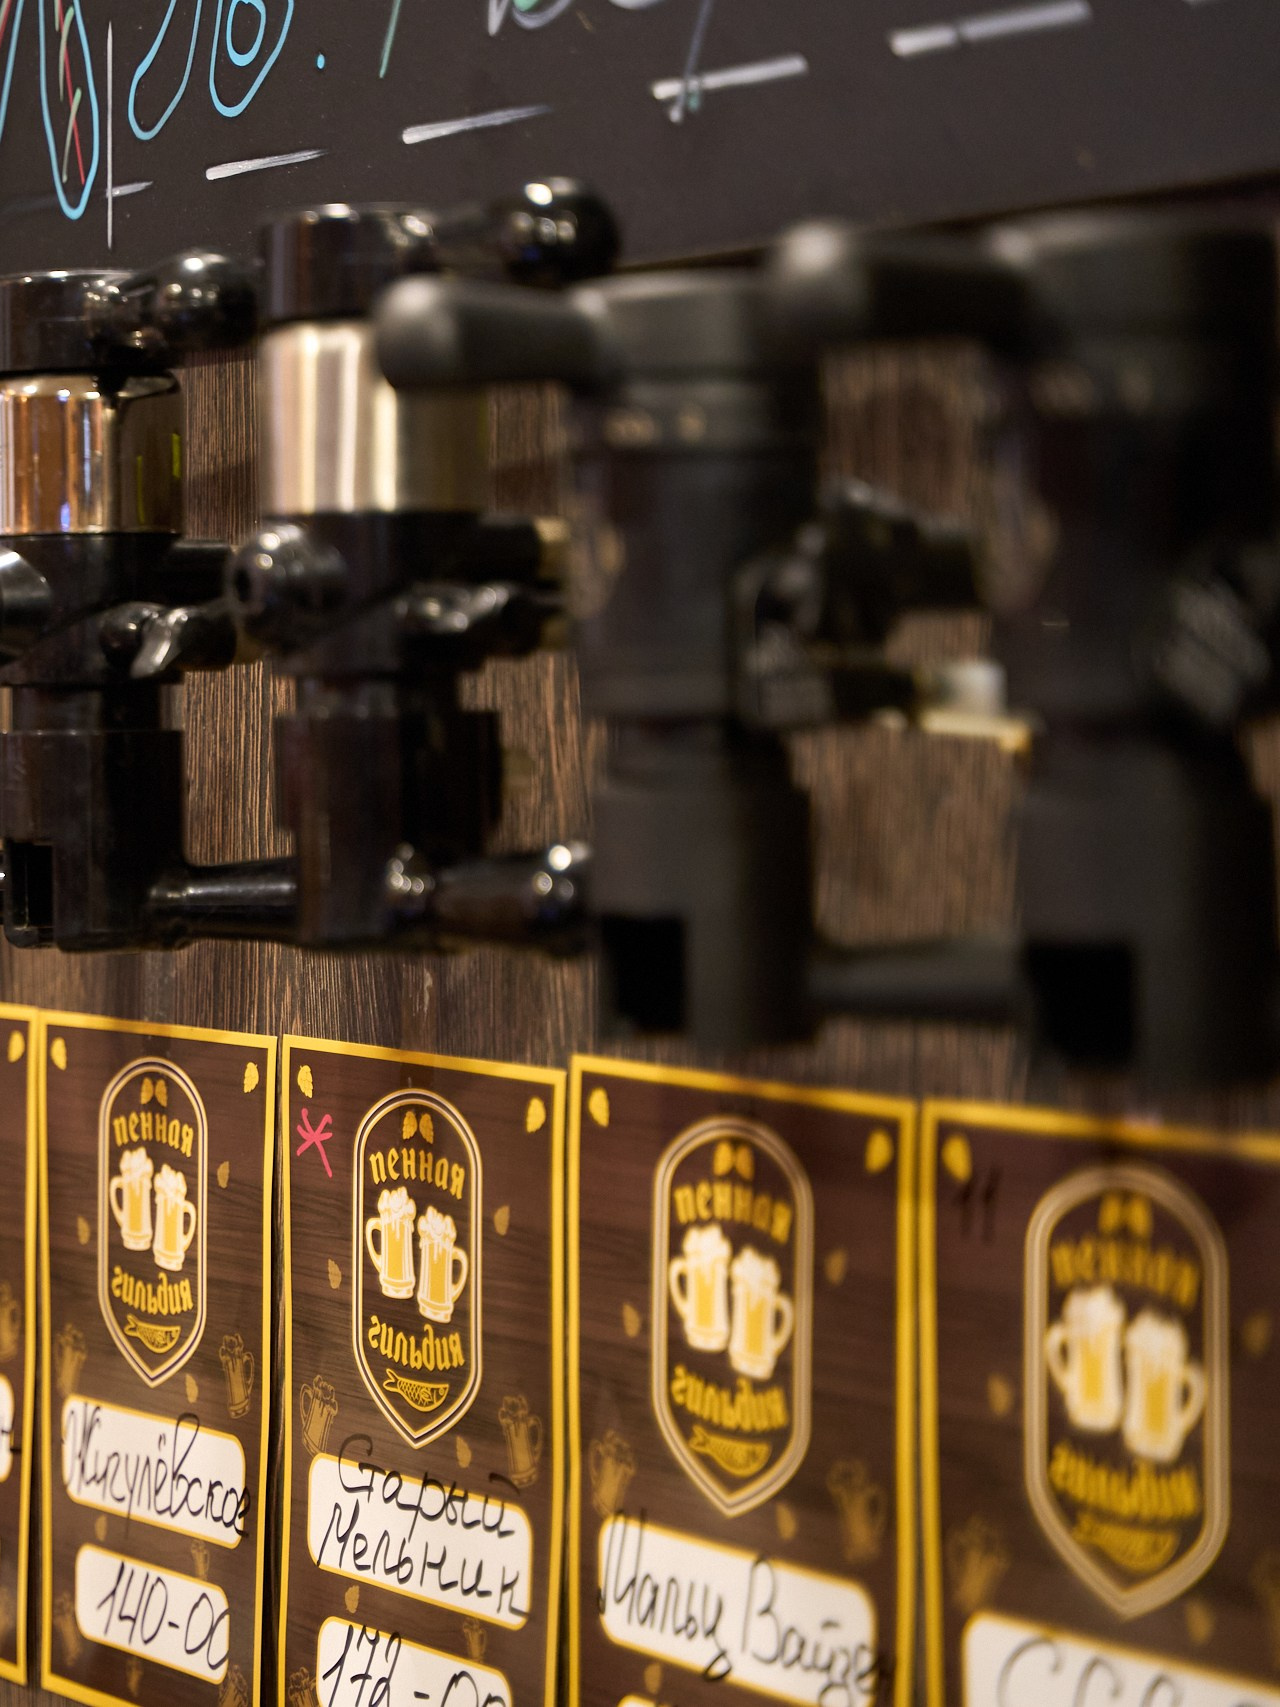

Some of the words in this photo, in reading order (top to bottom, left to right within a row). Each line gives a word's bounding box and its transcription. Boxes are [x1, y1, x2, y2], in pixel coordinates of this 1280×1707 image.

[369, 1147, 466, 1200] пенная
[368, 1315, 465, 1372] гильдия
[338, 1434, 520, 1542] Старый
[317, 1498, 530, 1617] Мельник
[96, 1561, 230, 1670] 140-00
